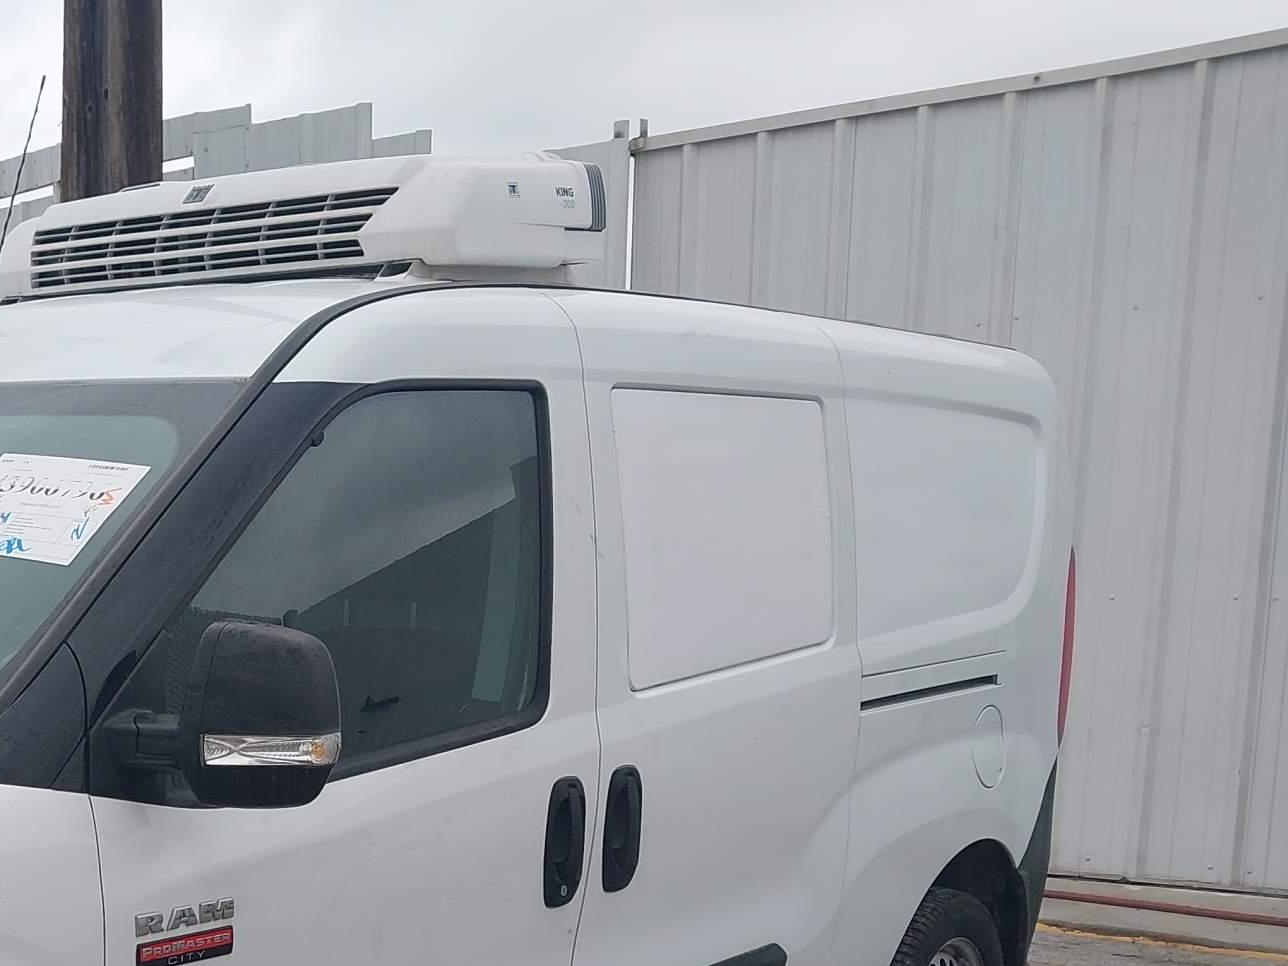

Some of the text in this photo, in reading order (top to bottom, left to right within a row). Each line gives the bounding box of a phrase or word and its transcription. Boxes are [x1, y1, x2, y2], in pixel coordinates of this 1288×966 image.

[555, 187, 574, 197] KING
[135, 897, 234, 937] RAM
[167, 950, 206, 965] CITY
